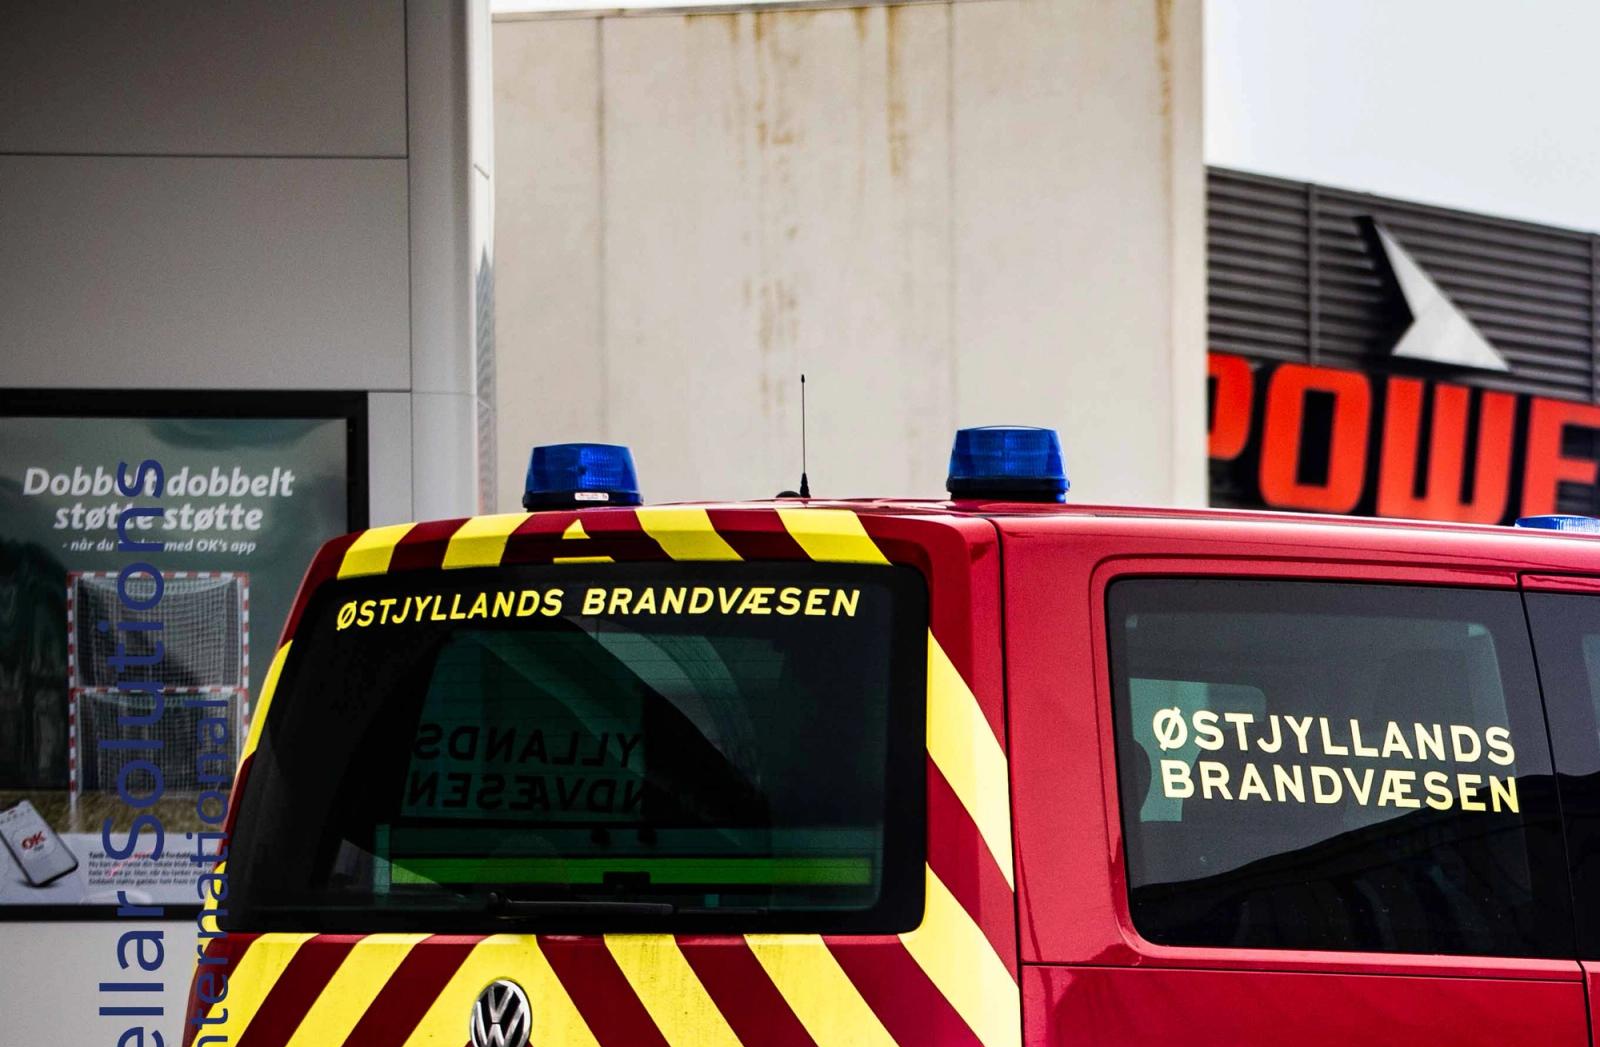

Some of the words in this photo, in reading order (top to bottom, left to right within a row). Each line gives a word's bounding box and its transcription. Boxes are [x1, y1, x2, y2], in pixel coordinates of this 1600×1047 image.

[167, 466, 296, 497] dobbelt
[162, 503, 264, 531] støtte
[71, 538, 94, 551] når
[96, 538, 114, 551] du
[164, 538, 194, 551] med
[196, 539, 227, 552] OK's
[231, 543, 256, 555] app
[335, 588, 564, 631] ØSTJYLLANDS
[581, 586, 861, 617] BRANDVÆSEN
[1152, 706, 1516, 766] ØSTJYLLANDS
[1160, 759, 1520, 814] BRANDVÆSEN
